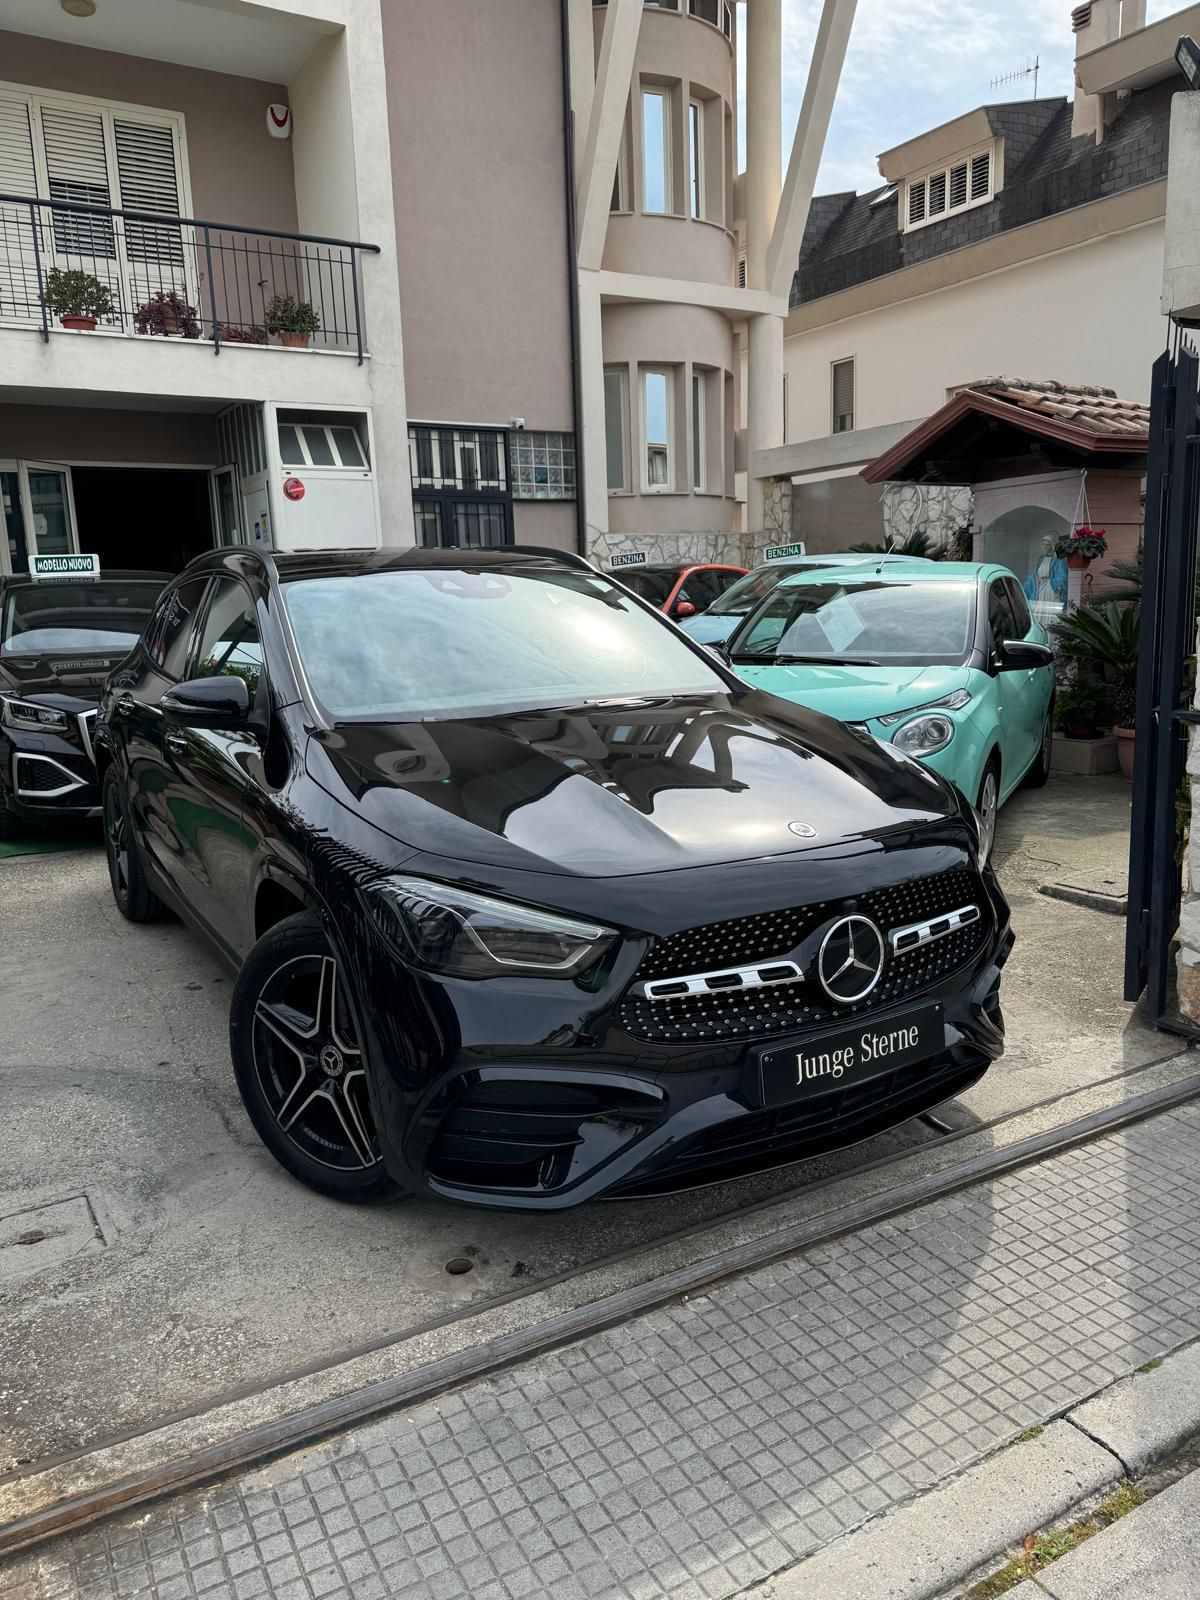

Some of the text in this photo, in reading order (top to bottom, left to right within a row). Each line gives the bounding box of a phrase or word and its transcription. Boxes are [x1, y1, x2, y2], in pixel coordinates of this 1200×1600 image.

[767, 545, 799, 558] BENZINA
[37, 557, 92, 571] MODELLO NUOVO
[613, 553, 644, 566] BENZINA
[796, 1026, 919, 1085] Junge Sterne
